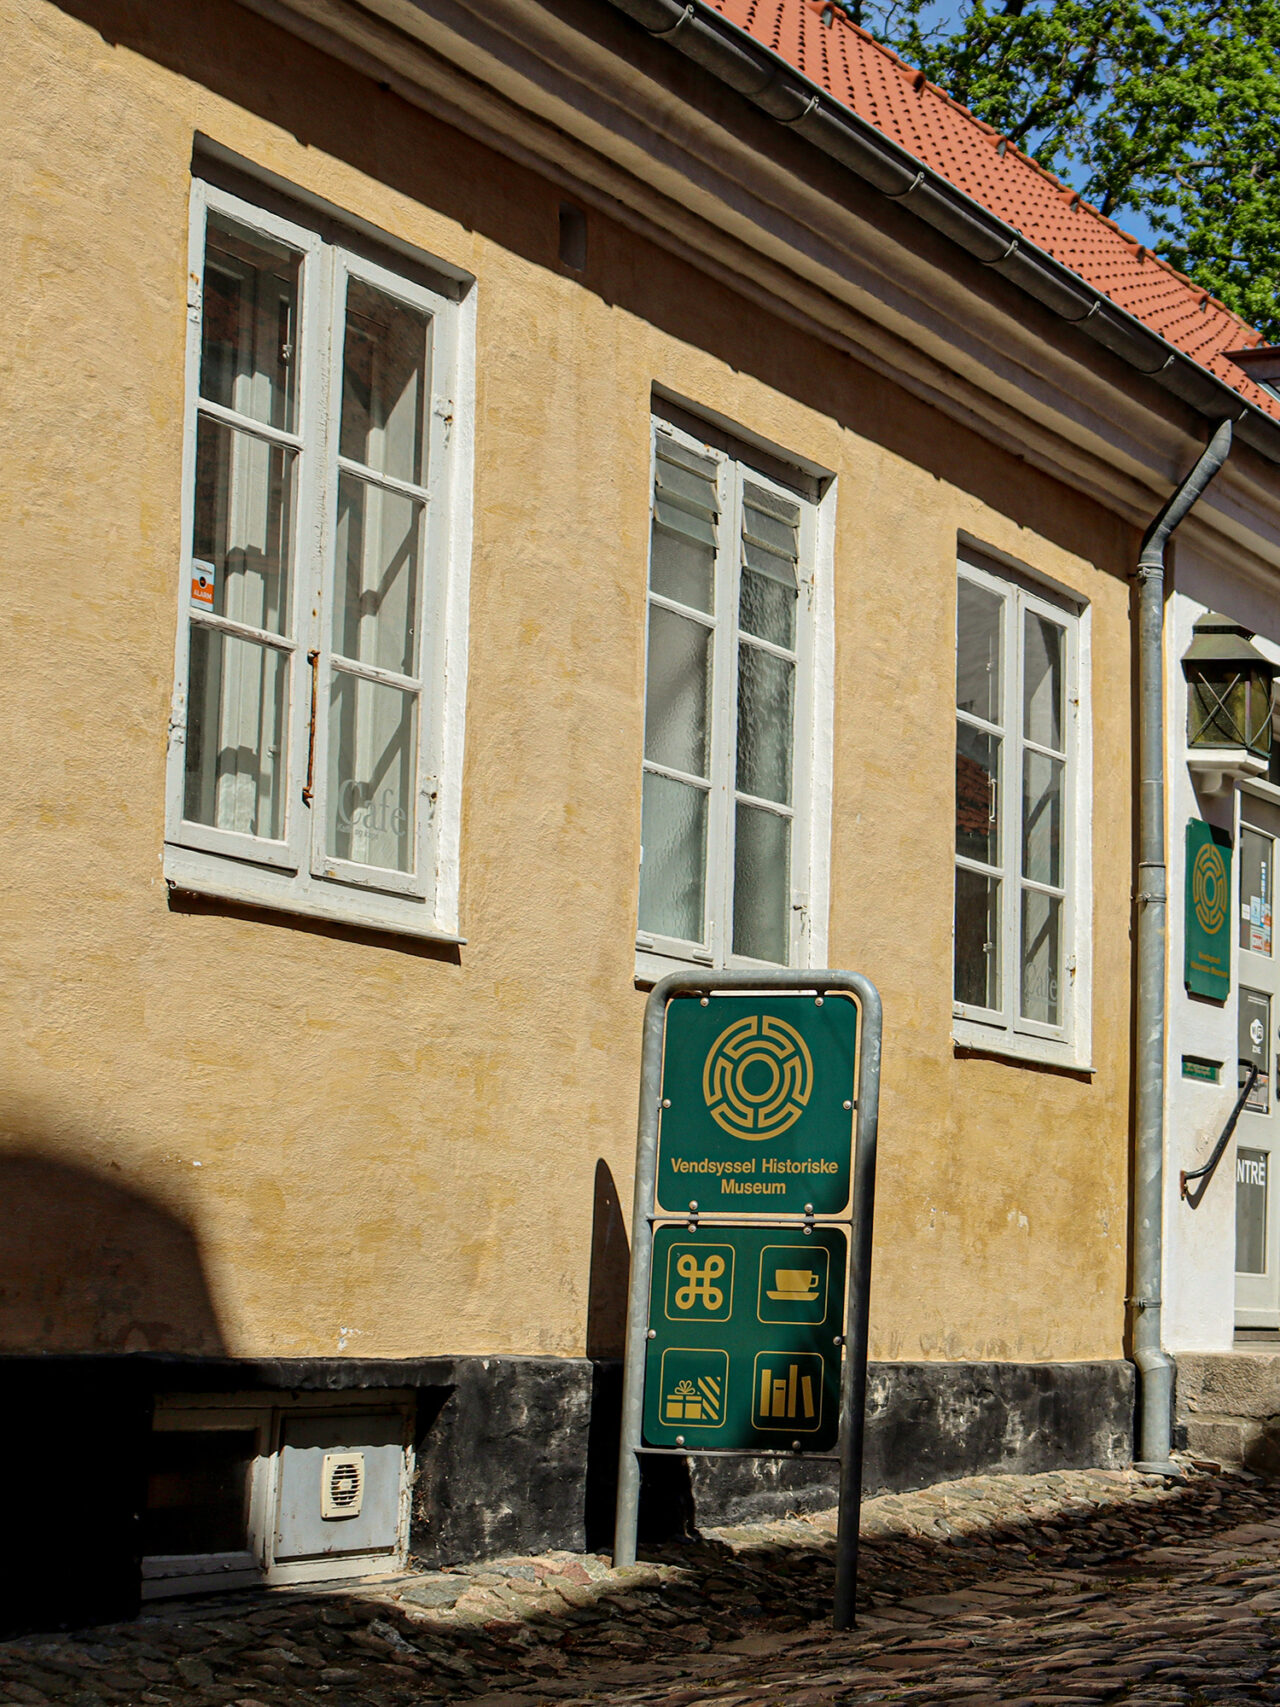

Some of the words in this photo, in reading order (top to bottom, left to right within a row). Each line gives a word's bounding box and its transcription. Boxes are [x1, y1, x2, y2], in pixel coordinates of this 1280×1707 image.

[338, 779, 406, 837] Cafe
[671, 1158, 756, 1177] Vendsyssel
[761, 1158, 839, 1174] Historiske
[720, 1178, 786, 1195] Museum
